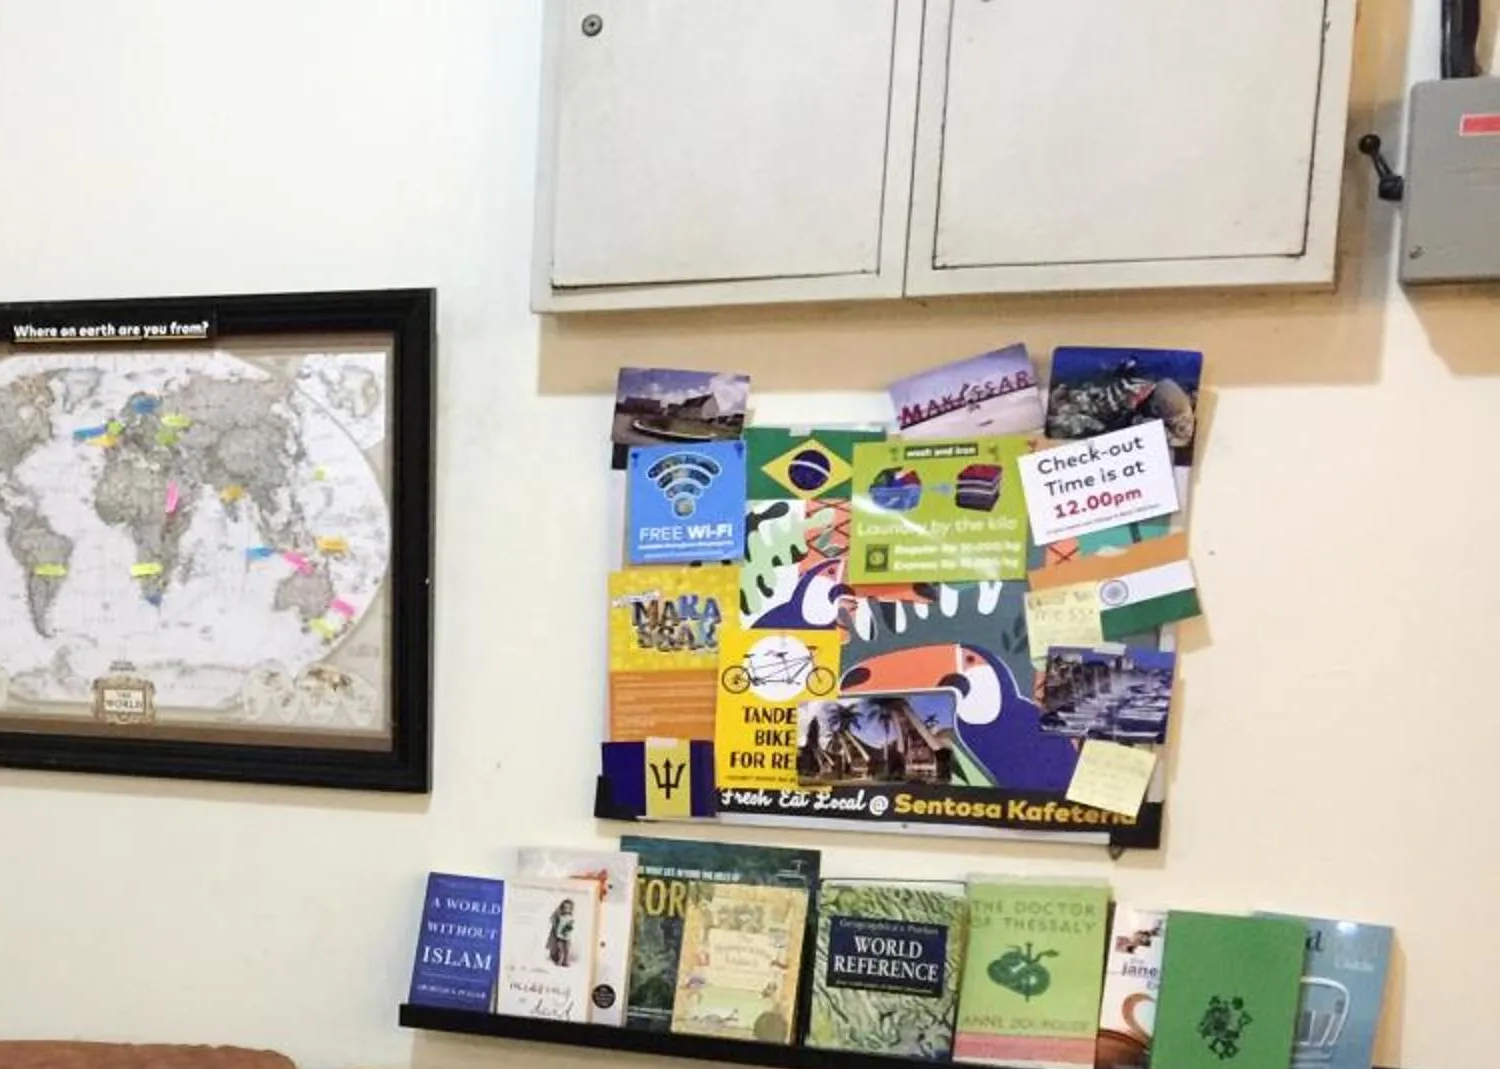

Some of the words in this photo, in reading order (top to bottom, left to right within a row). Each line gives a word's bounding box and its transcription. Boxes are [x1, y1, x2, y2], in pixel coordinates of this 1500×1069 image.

[13, 325, 57, 337] Where
[60, 326, 76, 337] on
[79, 323, 116, 337] earth
[118, 325, 140, 337] are
[143, 324, 167, 338] you
[169, 321, 209, 336] from?
[1037, 436, 1145, 475] Check-out
[1043, 473, 1096, 497] Time
[1100, 467, 1117, 483] is
[1123, 460, 1146, 477] at
[1054, 487, 1143, 519] 12.00pm
[639, 526, 683, 542] FREE
[742, 706, 797, 725] TANDE
[730, 751, 765, 769] FOR
[771, 752, 797, 770] RE
[813, 788, 867, 811] Local
[869, 795, 889, 815] @
[894, 793, 1001, 819] Sentosa
[432, 897, 441, 909] A
[447, 897, 501, 915] WORLD
[971, 899, 1004, 914] THE
[1014, 901, 1096, 918] DOCTOR
[427, 920, 499, 941] WITHOUT
[970, 915, 992, 929] OF
[1004, 916, 1098, 934] THESSALY
[854, 935, 923, 959] WORLD
[422, 945, 492, 971] ISLAM
[833, 954, 940, 983] REFERENCE
[1121, 962, 1158, 978] Jane
